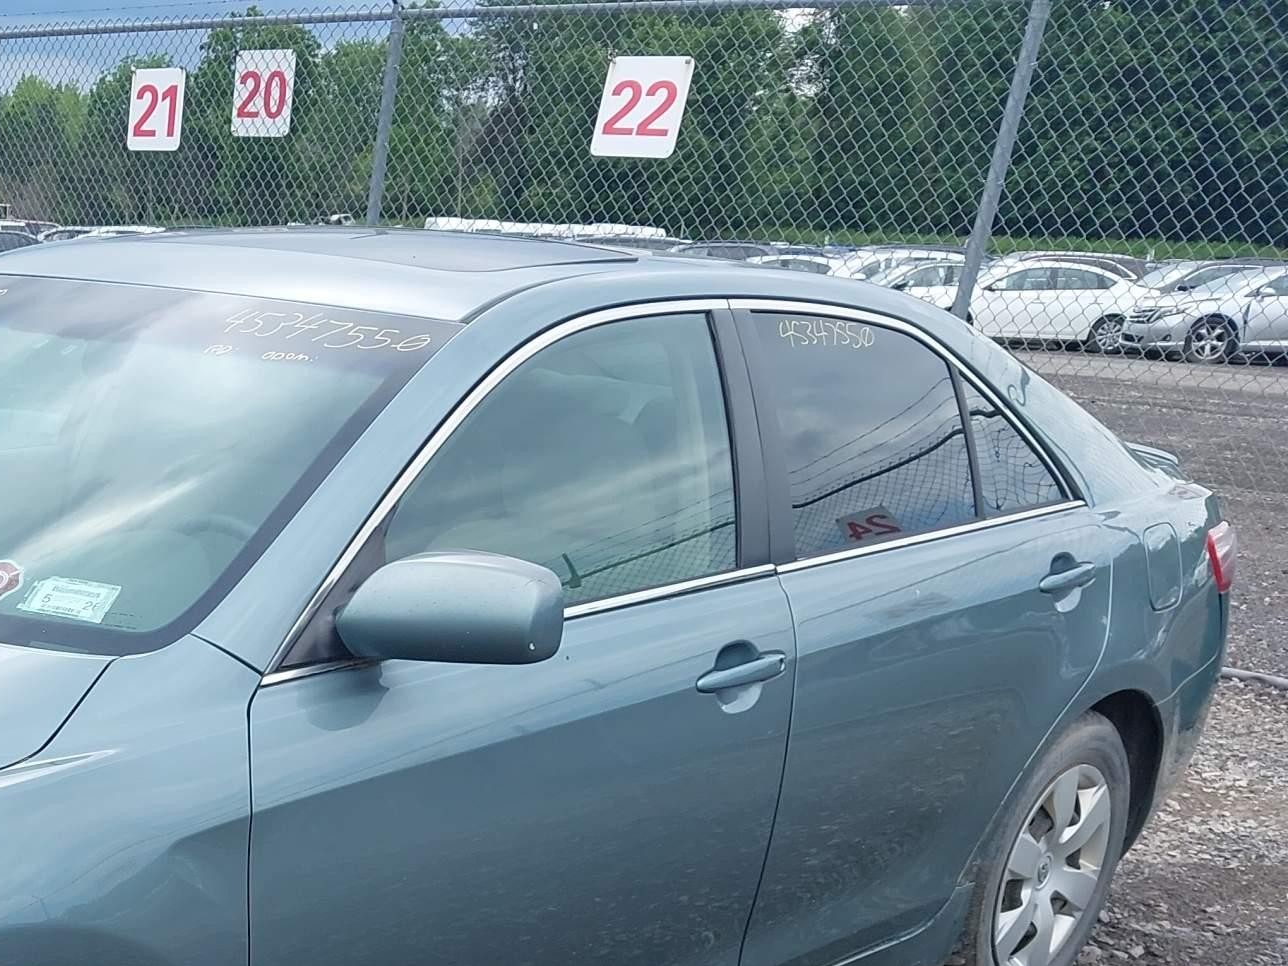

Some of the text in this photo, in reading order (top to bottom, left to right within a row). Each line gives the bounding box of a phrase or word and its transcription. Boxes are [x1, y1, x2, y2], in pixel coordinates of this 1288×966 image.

[133, 85, 178, 137] 21
[236, 71, 287, 118] 20
[602, 80, 677, 136] 22
[223, 308, 431, 351] 45347550
[778, 319, 875, 348] 45347550
